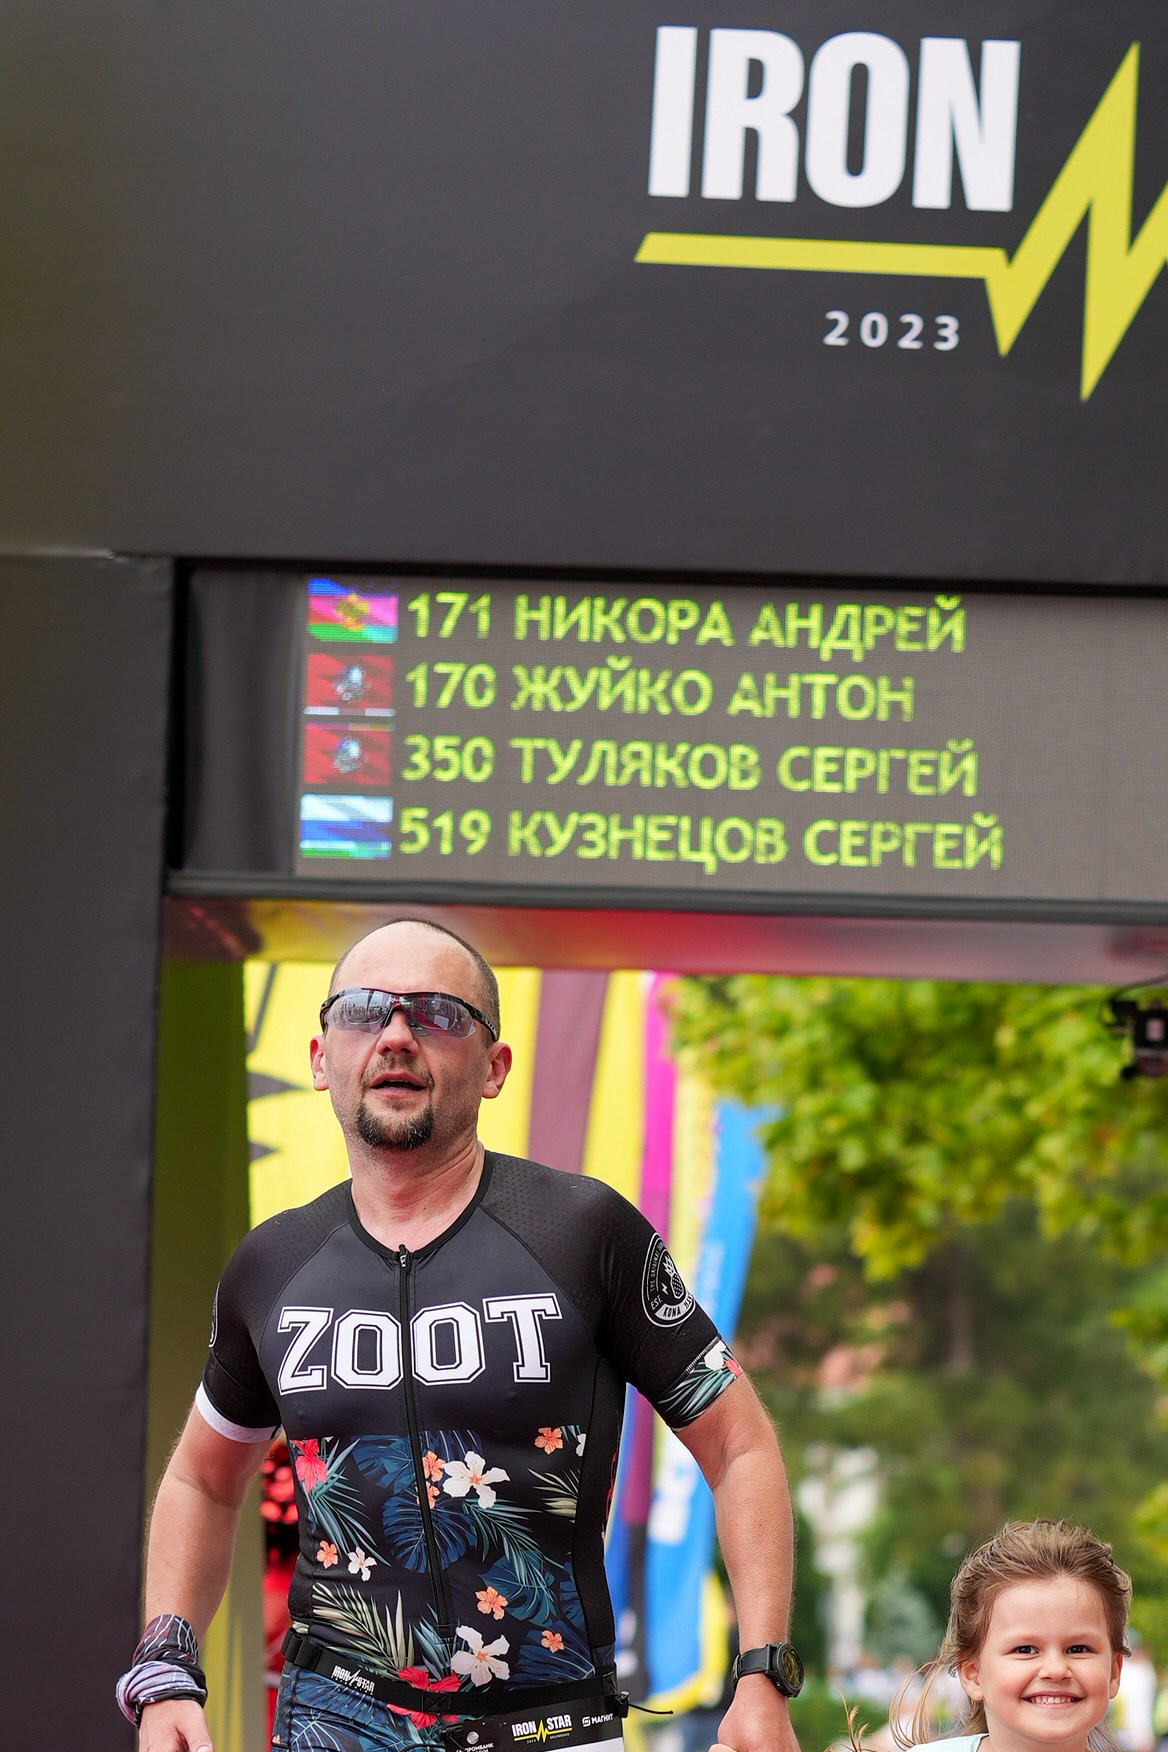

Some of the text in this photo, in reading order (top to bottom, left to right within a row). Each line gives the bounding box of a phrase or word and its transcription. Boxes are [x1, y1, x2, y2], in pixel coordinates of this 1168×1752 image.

[648, 26, 1021, 212] IRON
[823, 310, 960, 351] 2023
[406, 591, 492, 638] 171
[514, 593, 734, 645] НИКОРА
[749, 594, 967, 661] АНДРЕЙ
[404, 661, 497, 708] 170
[511, 655, 714, 716] ЖУЙКО
[727, 672, 915, 721] АНТОН
[401, 733, 495, 783] 350
[508, 736, 763, 790] ТУЛЯКОВ
[777, 738, 979, 797] СЕРГЕЙ
[399, 806, 493, 856] 519
[508, 809, 789, 875] КУЗНЕЦОВ
[803, 812, 1004, 870] СЕРГЕЙ
[277, 1293, 563, 1396] ZOOT
[512, 1721, 537, 1737] IRON
[546, 1714, 572, 1731] STAR
